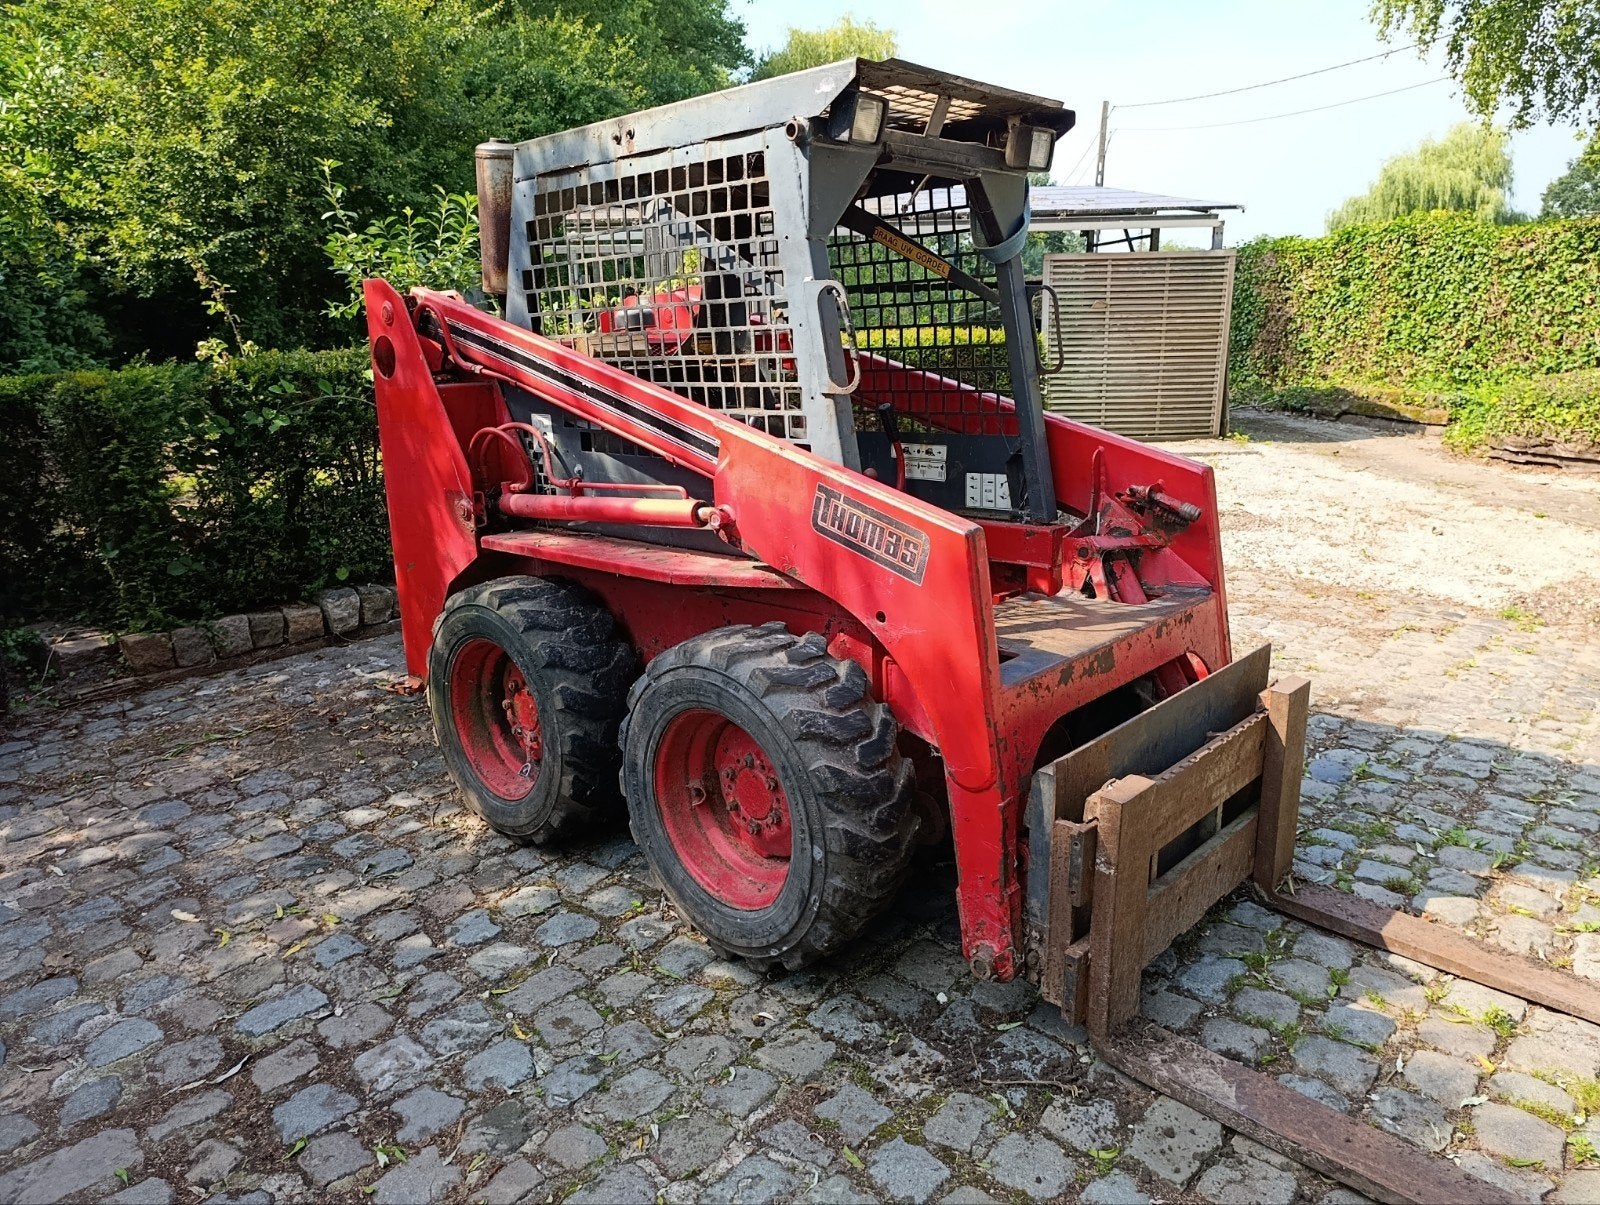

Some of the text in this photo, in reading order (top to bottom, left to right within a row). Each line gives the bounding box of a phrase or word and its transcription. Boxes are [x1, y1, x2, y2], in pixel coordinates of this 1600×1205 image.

[873, 228, 946, 274] DRAAG UW GORDEL
